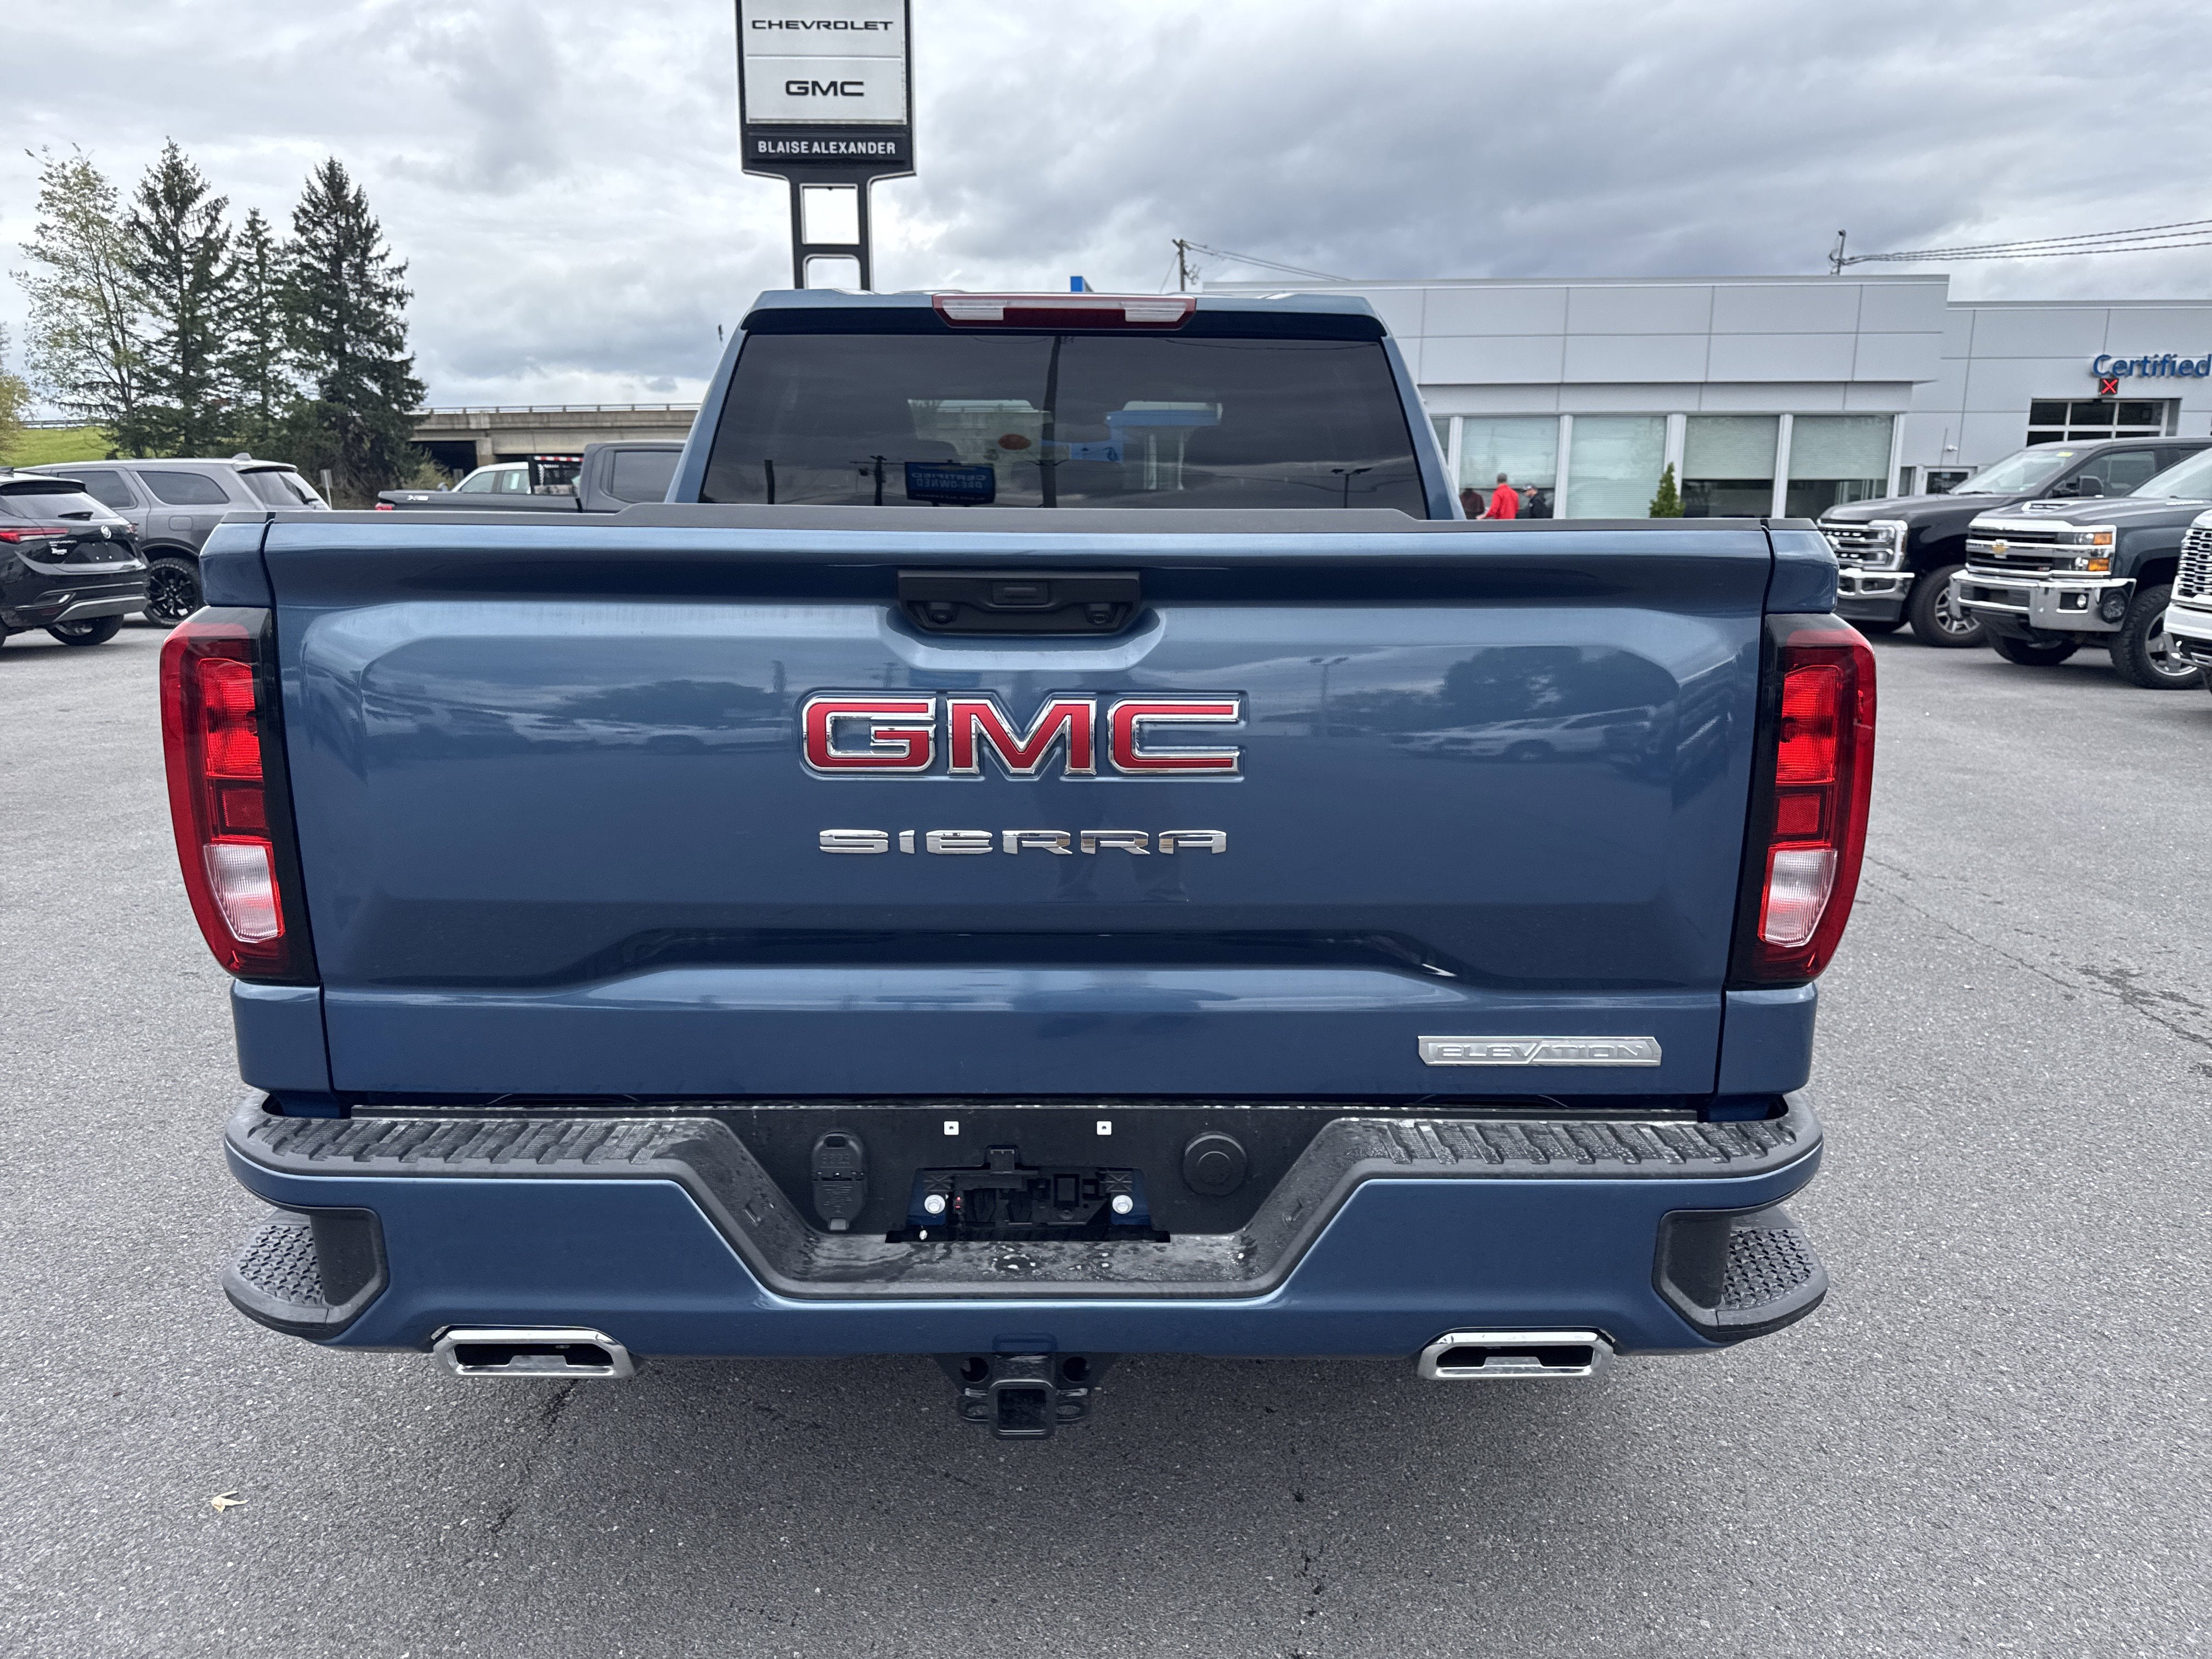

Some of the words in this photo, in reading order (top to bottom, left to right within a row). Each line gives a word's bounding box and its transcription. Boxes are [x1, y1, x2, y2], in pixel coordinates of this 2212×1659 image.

[752, 20, 893, 30] CHEVROLET
[786, 81, 865, 97] GMC
[758, 140, 809, 154] BLAISE
[811, 141, 896, 154] ALEXANDER
[2093, 353, 2212, 377] Certified
[802, 696, 1242, 776] GMC
[819, 830, 1228, 855] SIERRA
[1437, 1043, 1644, 1057] ELEVATION
